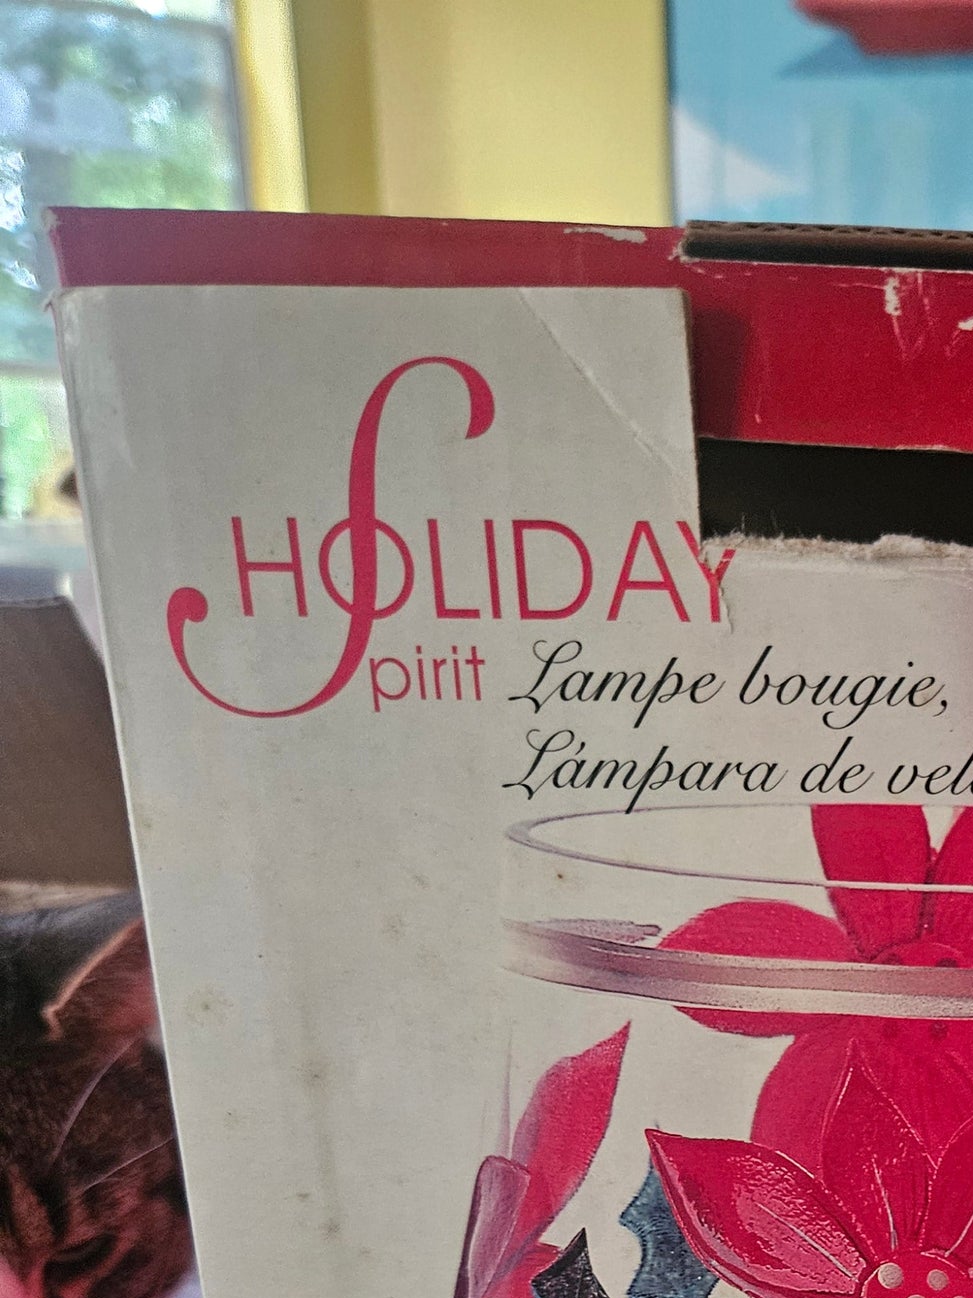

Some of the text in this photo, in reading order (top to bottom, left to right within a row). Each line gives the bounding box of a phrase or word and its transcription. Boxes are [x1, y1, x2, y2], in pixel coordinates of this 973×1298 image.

[230, 515, 737, 624] HOLIDAY
[507, 640, 727, 729] Lampe
[739, 645, 950, 730] bougie,
[501, 729, 789, 815] Lámpara
[800, 736, 875, 795] de
